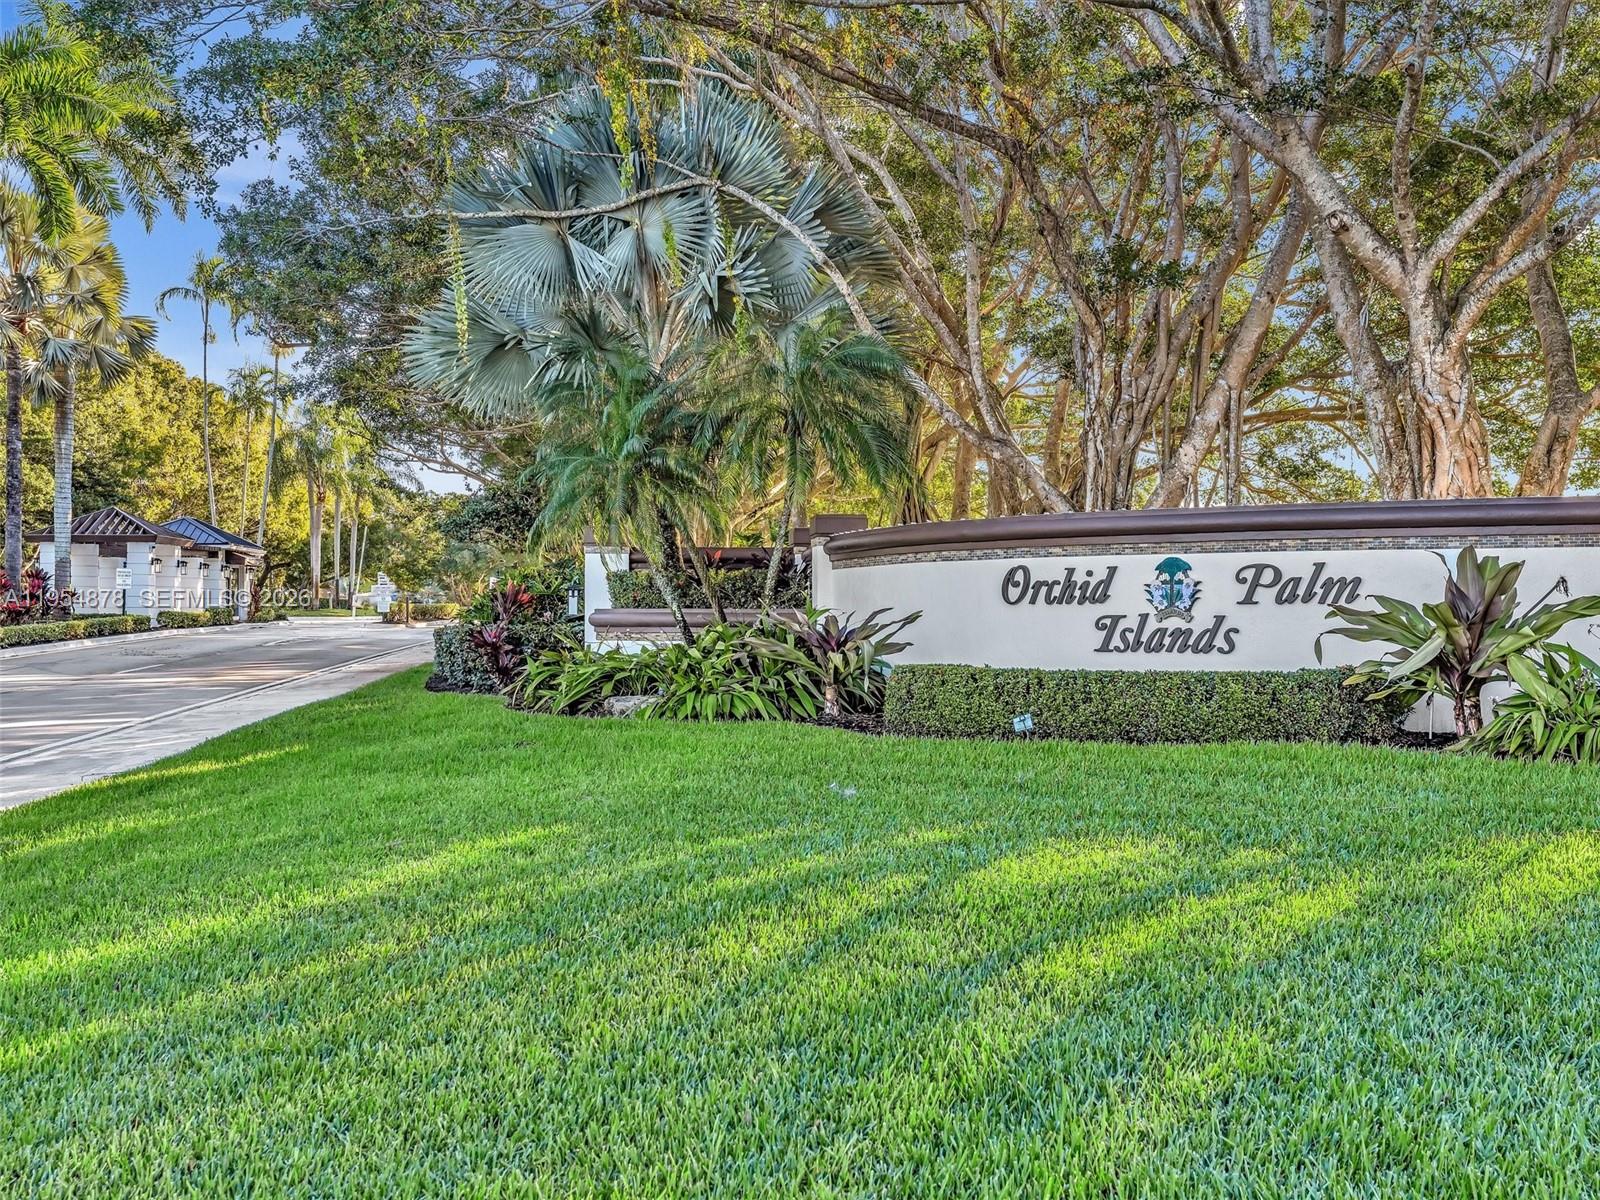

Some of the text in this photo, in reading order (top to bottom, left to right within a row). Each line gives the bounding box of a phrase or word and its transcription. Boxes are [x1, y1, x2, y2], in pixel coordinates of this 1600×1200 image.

[1001, 561, 1364, 606] Orchid Palm
[1093, 613, 1240, 655] Islands
